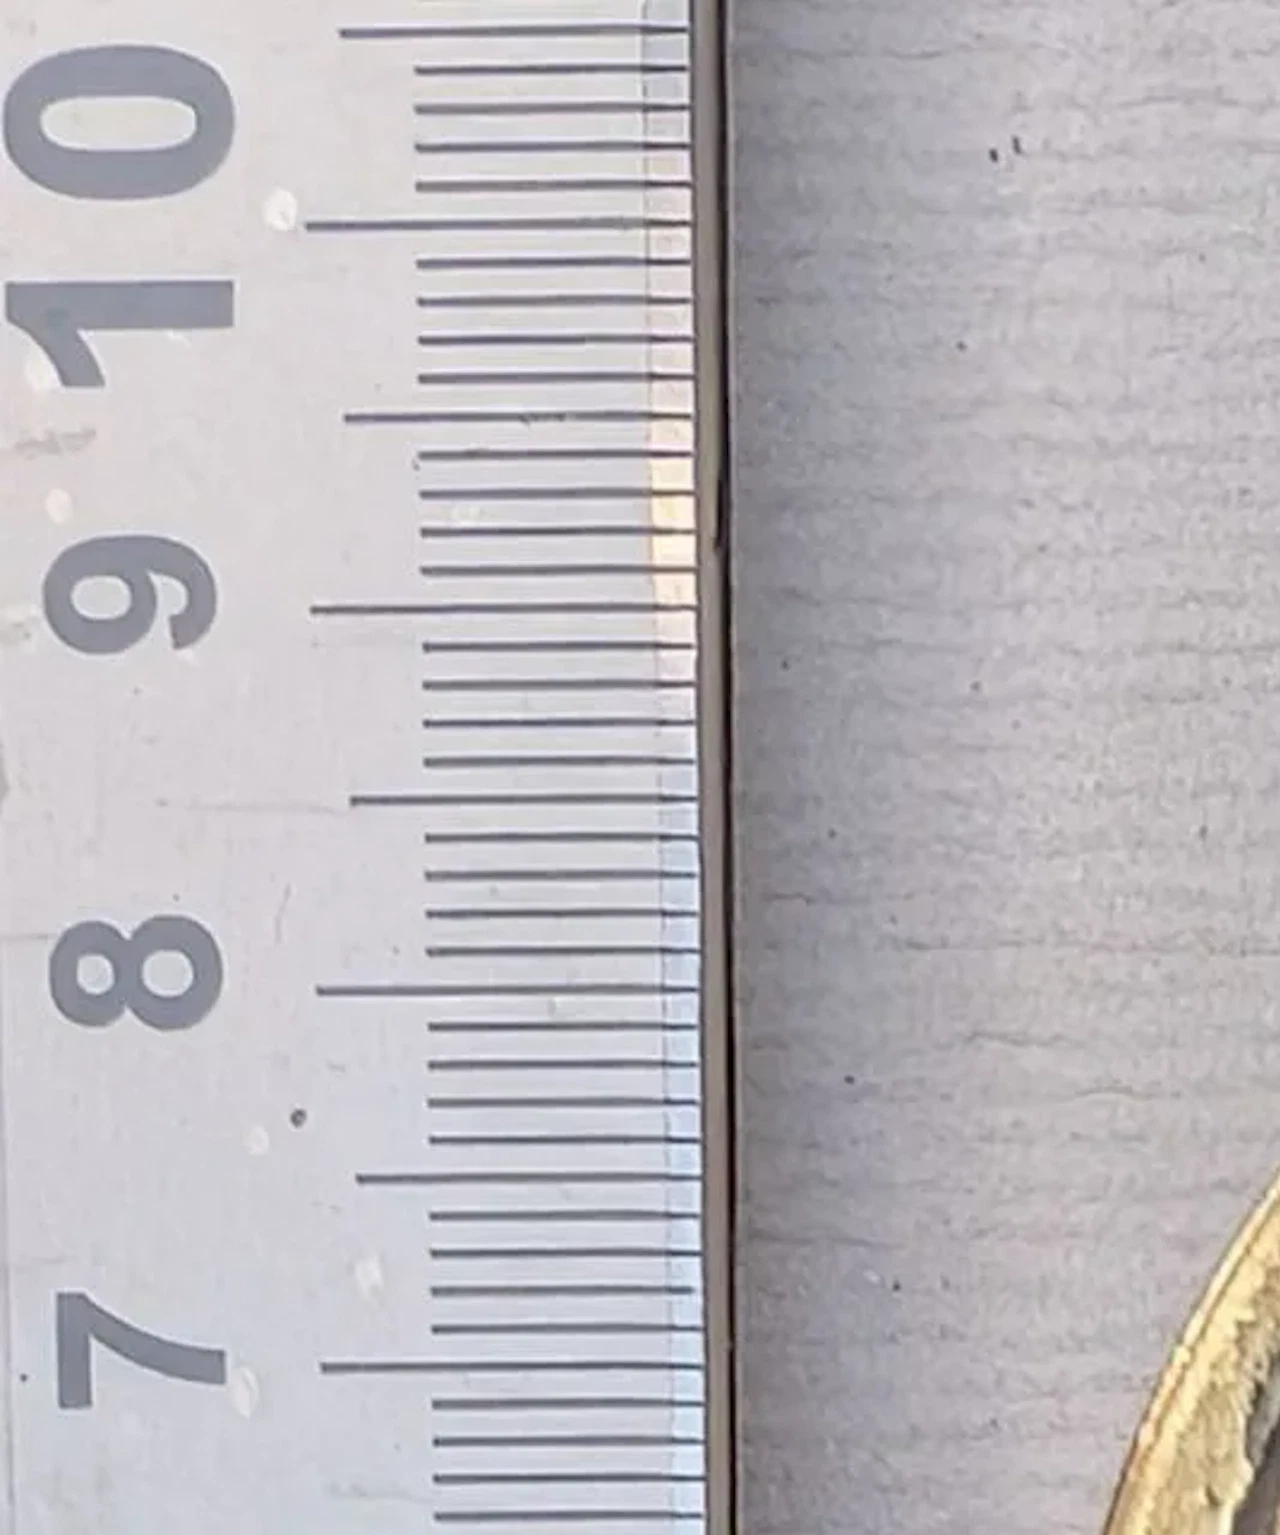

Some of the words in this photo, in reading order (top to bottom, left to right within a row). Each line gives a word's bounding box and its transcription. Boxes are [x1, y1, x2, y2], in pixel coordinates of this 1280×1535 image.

[3, 44, 235, 388] 10
[42, 534, 217, 654] 9
[48, 914, 225, 1031] 8
[56, 1291, 227, 1410] 7
